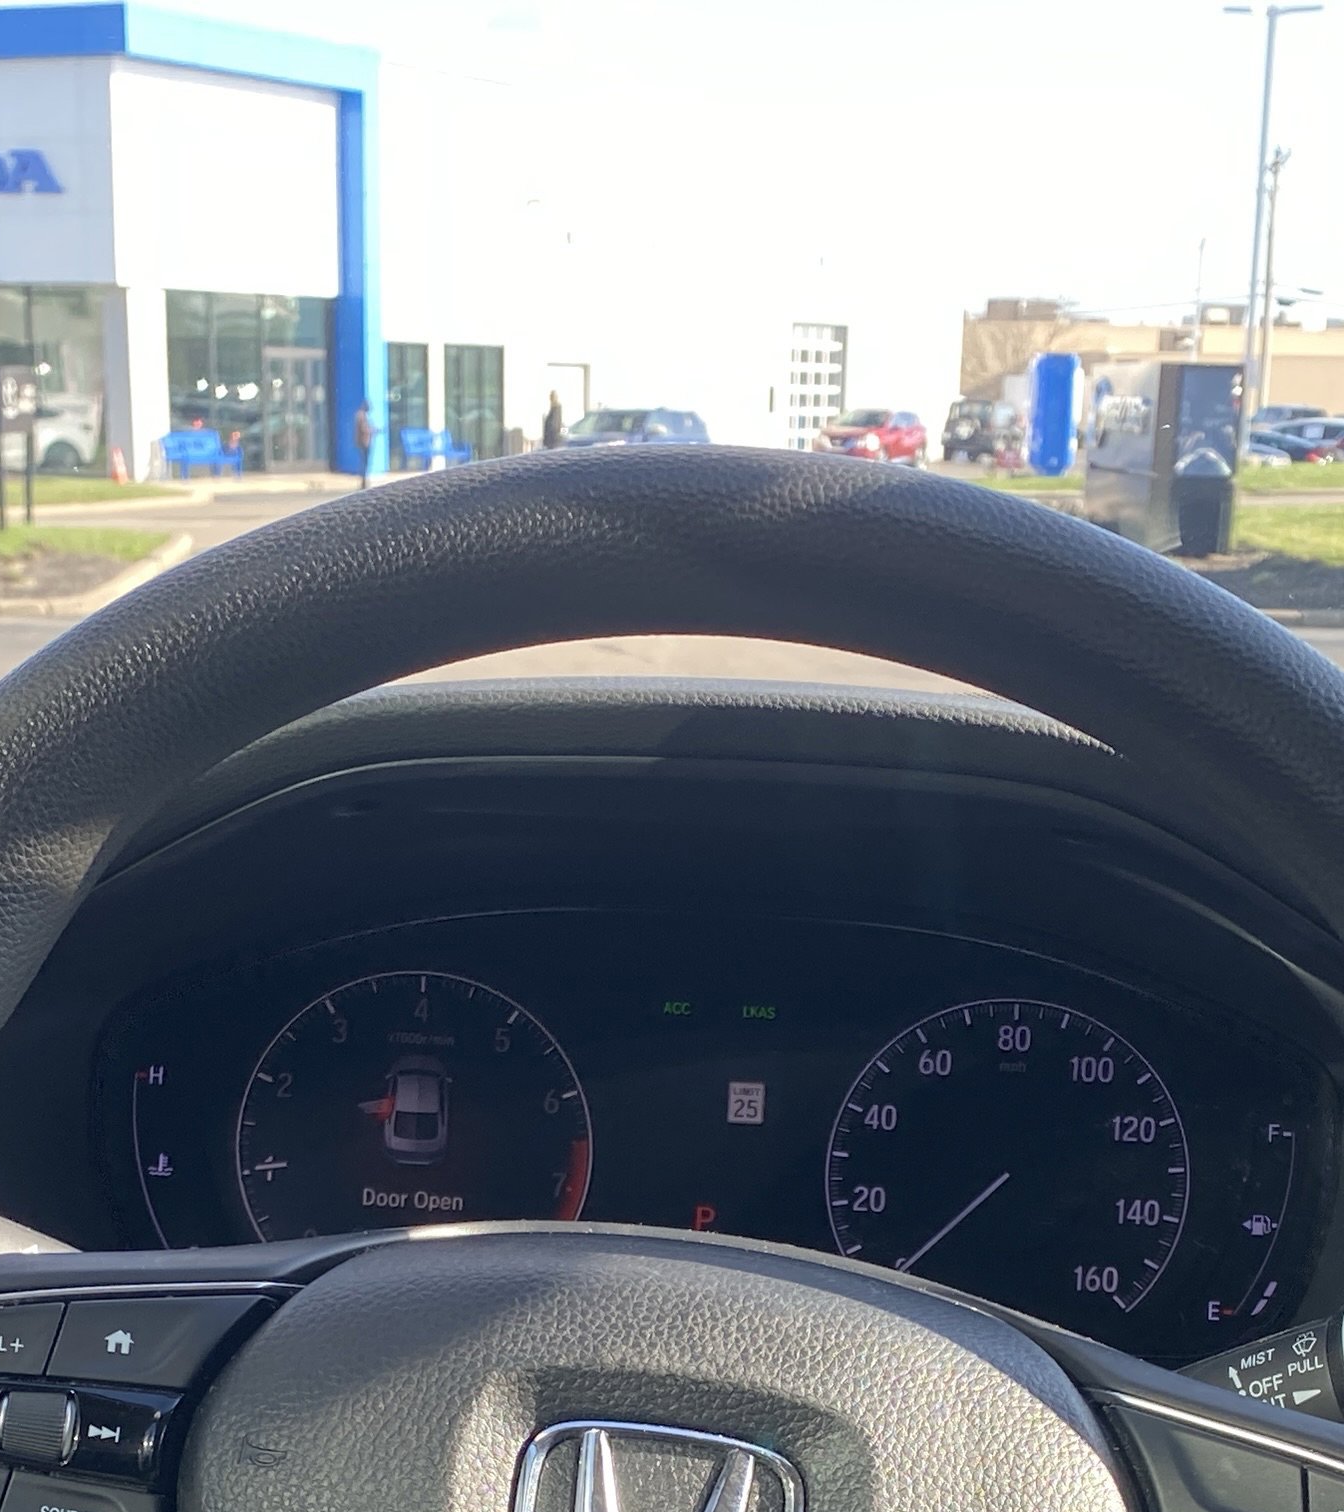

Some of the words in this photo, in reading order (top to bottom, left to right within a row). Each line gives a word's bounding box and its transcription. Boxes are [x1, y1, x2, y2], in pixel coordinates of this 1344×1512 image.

[414, 999, 430, 1023] 4
[663, 1001, 692, 1016] ACC
[742, 1005, 777, 1020] LKAS
[332, 1018, 348, 1044] 3
[494, 1028, 511, 1053] 5
[997, 1026, 1031, 1052] 80
[149, 1066, 165, 1085] H
[918, 1050, 953, 1077] 60
[1070, 1056, 1115, 1083] 100
[276, 1074, 293, 1098] 2
[543, 1090, 560, 1114] 6
[734, 1098, 758, 1118] 25
[863, 1105, 898, 1131] 40
[1112, 1116, 1157, 1143] 120
[1267, 1123, 1281, 1144] F
[552, 1172, 567, 1197] 7
[362, 1187, 408, 1209] Door
[414, 1190, 464, 1212] Open
[852, 1186, 887, 1213] 20
[692, 1206, 716, 1230] P
[1115, 1199, 1160, 1226] 140
[1074, 1266, 1119, 1293] 160
[1208, 1300, 1222, 1321] E
[1240, 1347, 1275, 1370] MIST
[1287, 1356, 1324, 1377] PULL
[1249, 1373, 1283, 1398] OFF
